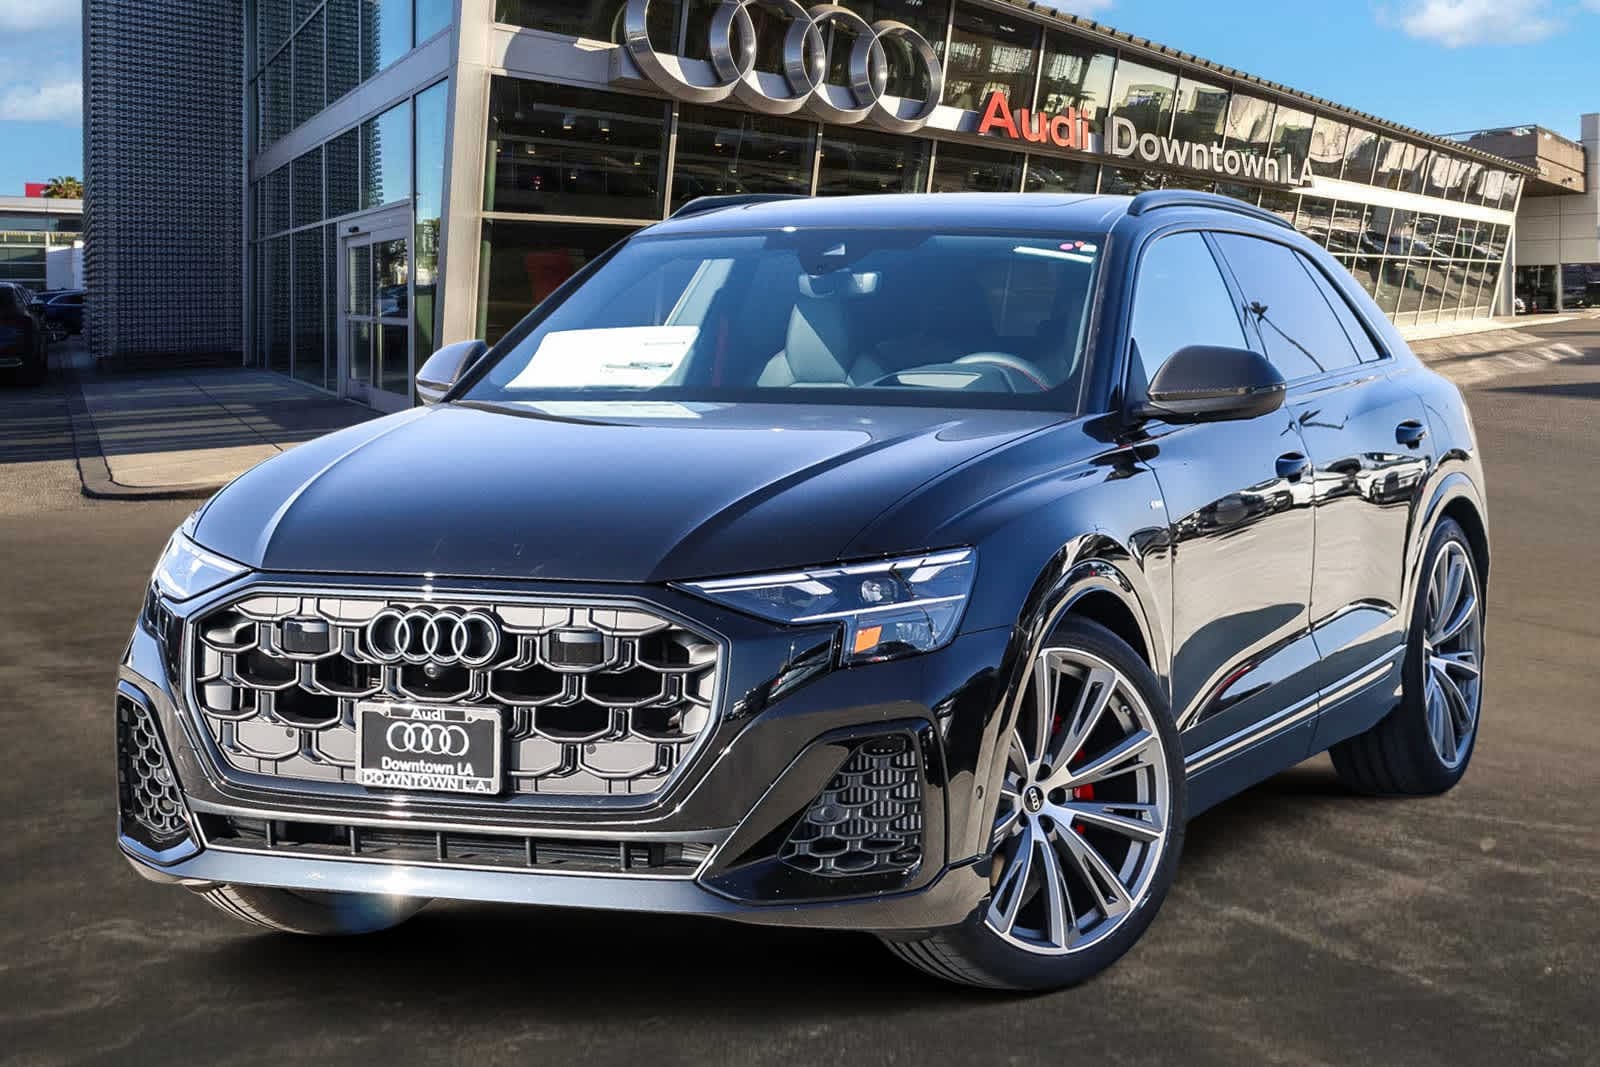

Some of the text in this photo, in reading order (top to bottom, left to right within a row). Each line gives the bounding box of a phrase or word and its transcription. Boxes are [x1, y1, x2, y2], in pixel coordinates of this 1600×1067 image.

[978, 91, 1315, 188] Audi Downtown LA
[410, 707, 446, 721] Audi
[381, 756, 475, 777] Downtown LA
[364, 771, 458, 790] DOWNTOWN
